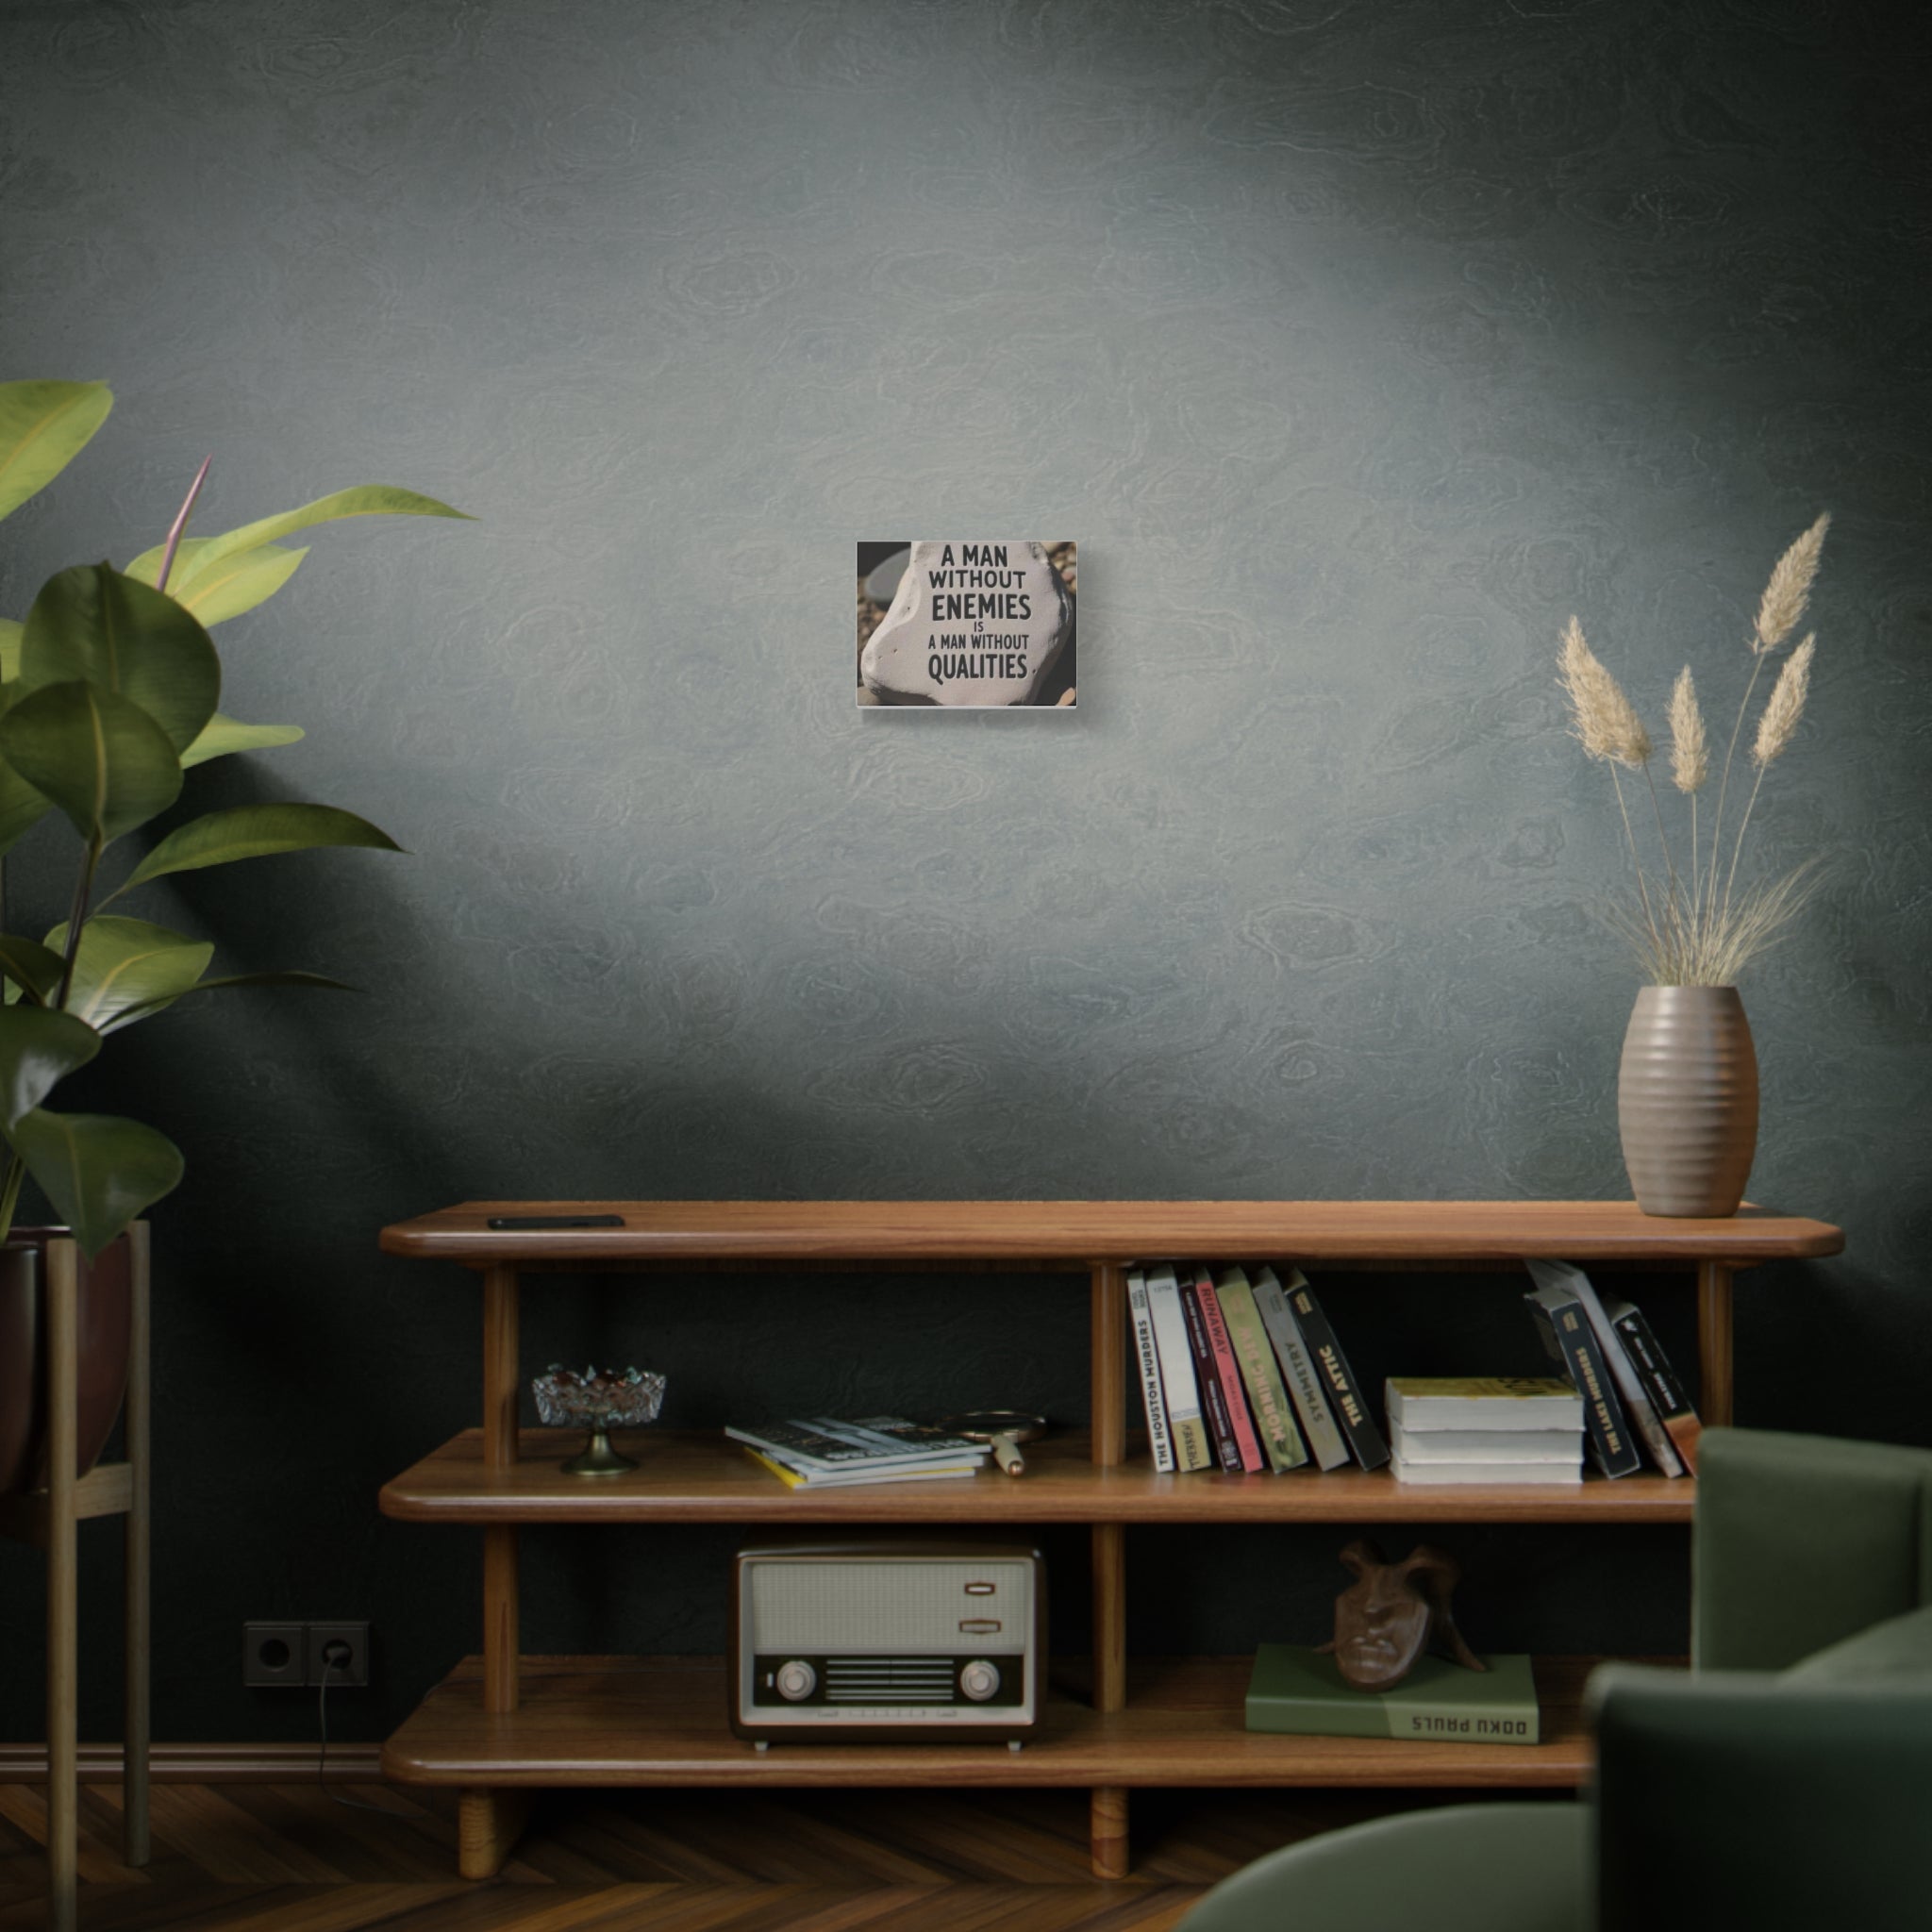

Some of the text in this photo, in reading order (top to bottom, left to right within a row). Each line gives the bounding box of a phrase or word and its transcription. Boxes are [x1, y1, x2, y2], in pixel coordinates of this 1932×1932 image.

[941, 544, 1008, 567] A MAN
[928, 570, 1026, 589] WITHOUT
[932, 593, 1031, 621] ENEMIES
[928, 635, 1029, 650] A MAN WITHOUT
[974, 622, 984, 632] IS
[928, 654, 1028, 685] QUALITIES
[1201, 1288, 1229, 1355] RUNAWAY
[1138, 1320, 1169, 1466] THE HOUSTON MURDERS
[1285, 1341, 1325, 1424] SYMMETRY
[1319, 1344, 1363, 1427] THE ATTIC
[1250, 1363, 1287, 1443] MORNING
[1575, 1346, 1622, 1455] THE LAKE MURDERS
[1412, 1716, 1470, 1732] PAULS
